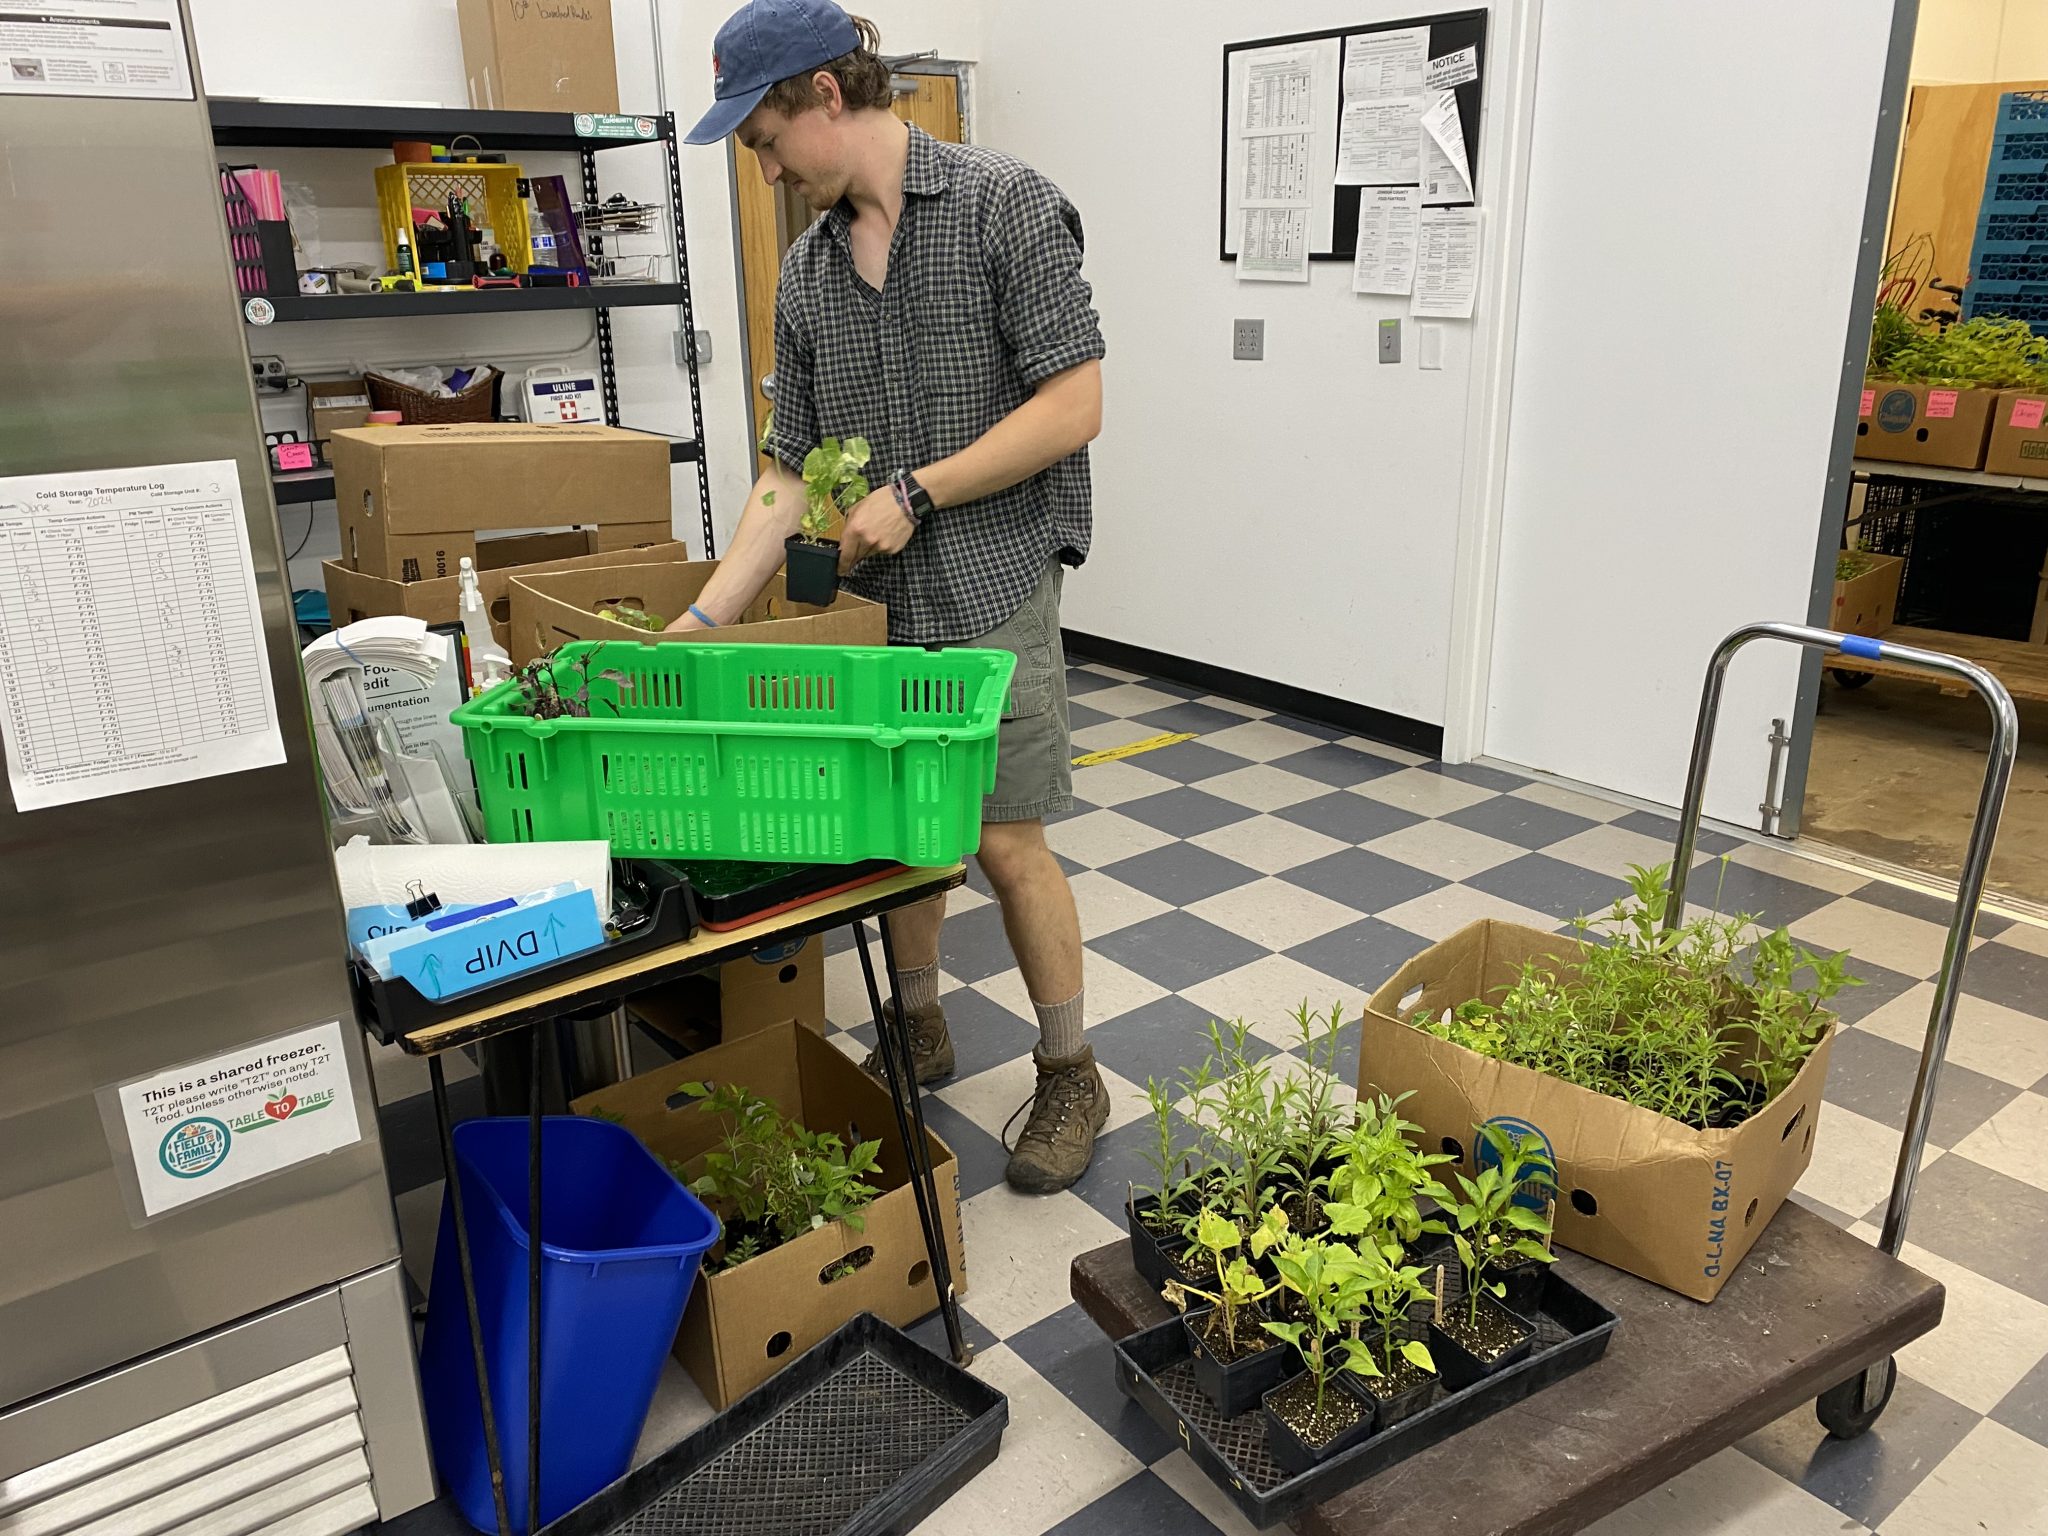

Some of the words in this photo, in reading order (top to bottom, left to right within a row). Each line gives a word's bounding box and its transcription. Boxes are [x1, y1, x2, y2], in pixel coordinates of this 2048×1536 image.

[1432, 52, 1465, 70] NOTICE
[552, 382, 576, 392] ULINE
[95, 484, 147, 494] Temperature
[209, 483, 220, 493] 3
[20, 501, 50, 513] June
[86, 496, 112, 508] 2024
[364, 665, 399, 676] Foo
[363, 677, 390, 690] edit
[368, 696, 429, 712] umentation
[465, 930, 539, 974] DVIP
[142, 1087, 176, 1103] This
[180, 1082, 193, 1092] is
[197, 1078, 206, 1087] a
[210, 1058, 264, 1083] shared
[266, 1043, 326, 1066] freezer.
[143, 1104, 165, 1117] T2T
[168, 1092, 206, 1112] please
[209, 1083, 238, 1097] write
[240, 1071, 270, 1086] "T2T"
[273, 1069, 287, 1077] on
[290, 1061, 309, 1073] any
[310, 1053, 331, 1066] T2T
[155, 1112, 184, 1125] food.
[186, 1097, 225, 1114] Unless
[228, 1080, 282, 1102] otherwise
[286, 1069, 319, 1084] noted.
[227, 1110, 265, 1128] TABLE
[273, 1102, 290, 1115] TO
[299, 1088, 335, 1107] TABLE
[174, 1134, 205, 1153] FIELD
[176, 1142, 216, 1165] FAMILY
